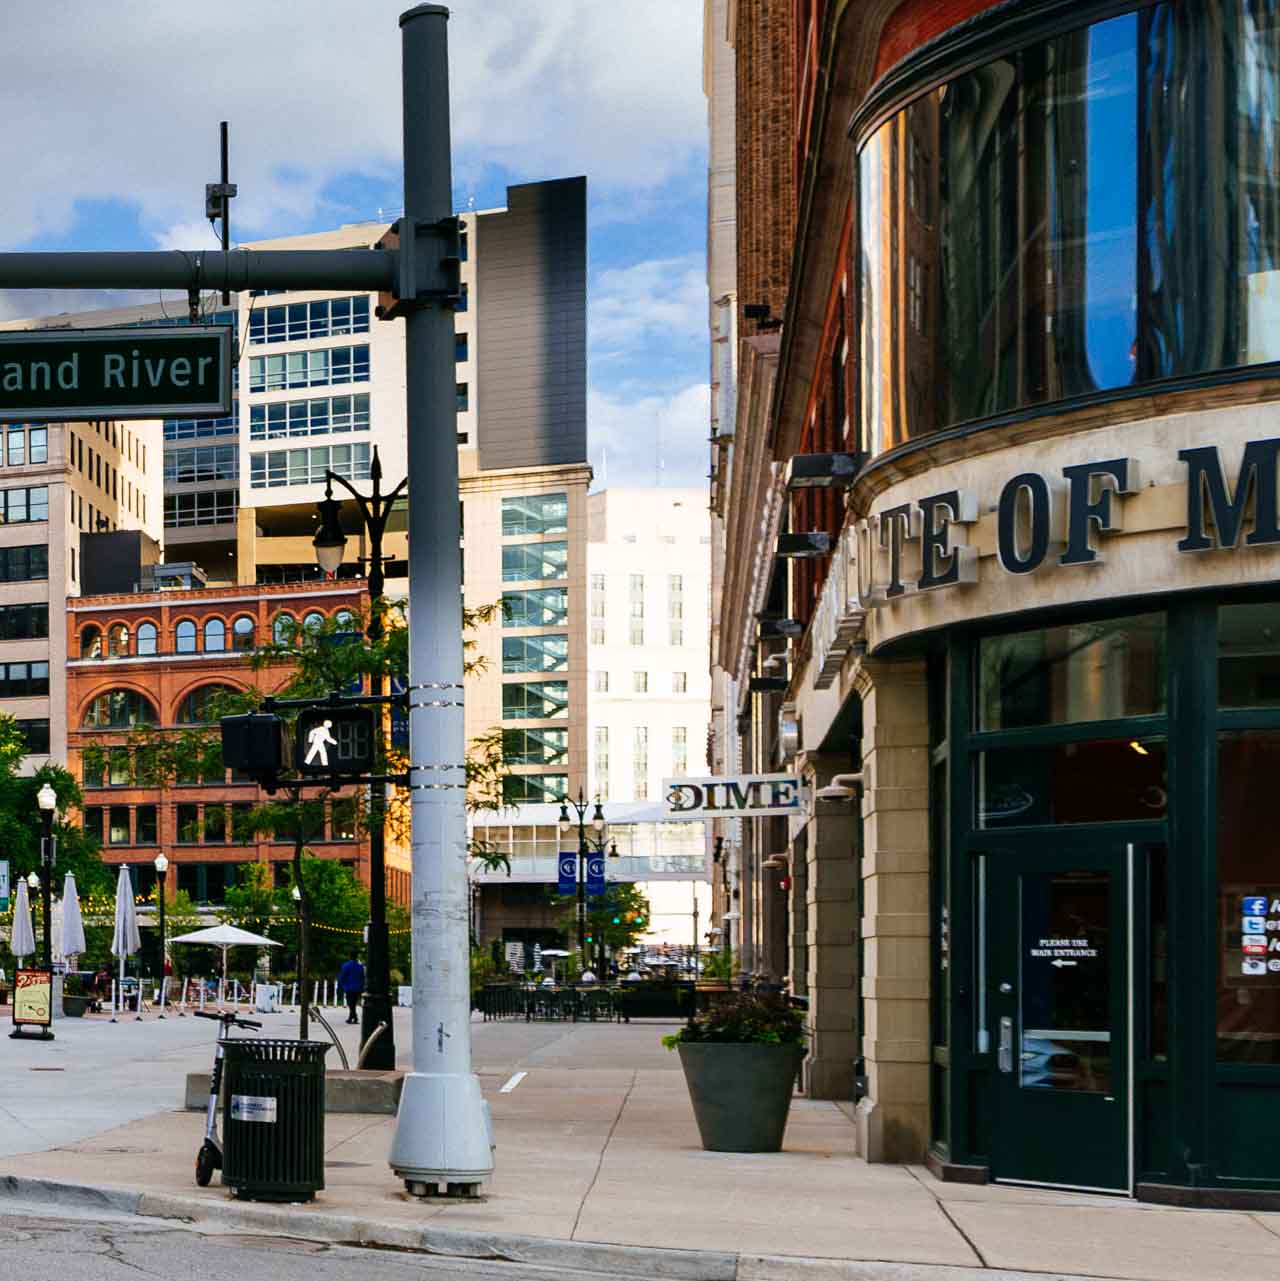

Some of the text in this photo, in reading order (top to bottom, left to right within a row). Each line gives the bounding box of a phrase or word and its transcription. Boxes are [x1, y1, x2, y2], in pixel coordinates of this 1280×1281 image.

[104, 349, 213, 389] River
[997, 456, 1130, 575] OF
[667, 780, 799, 812] DIME
